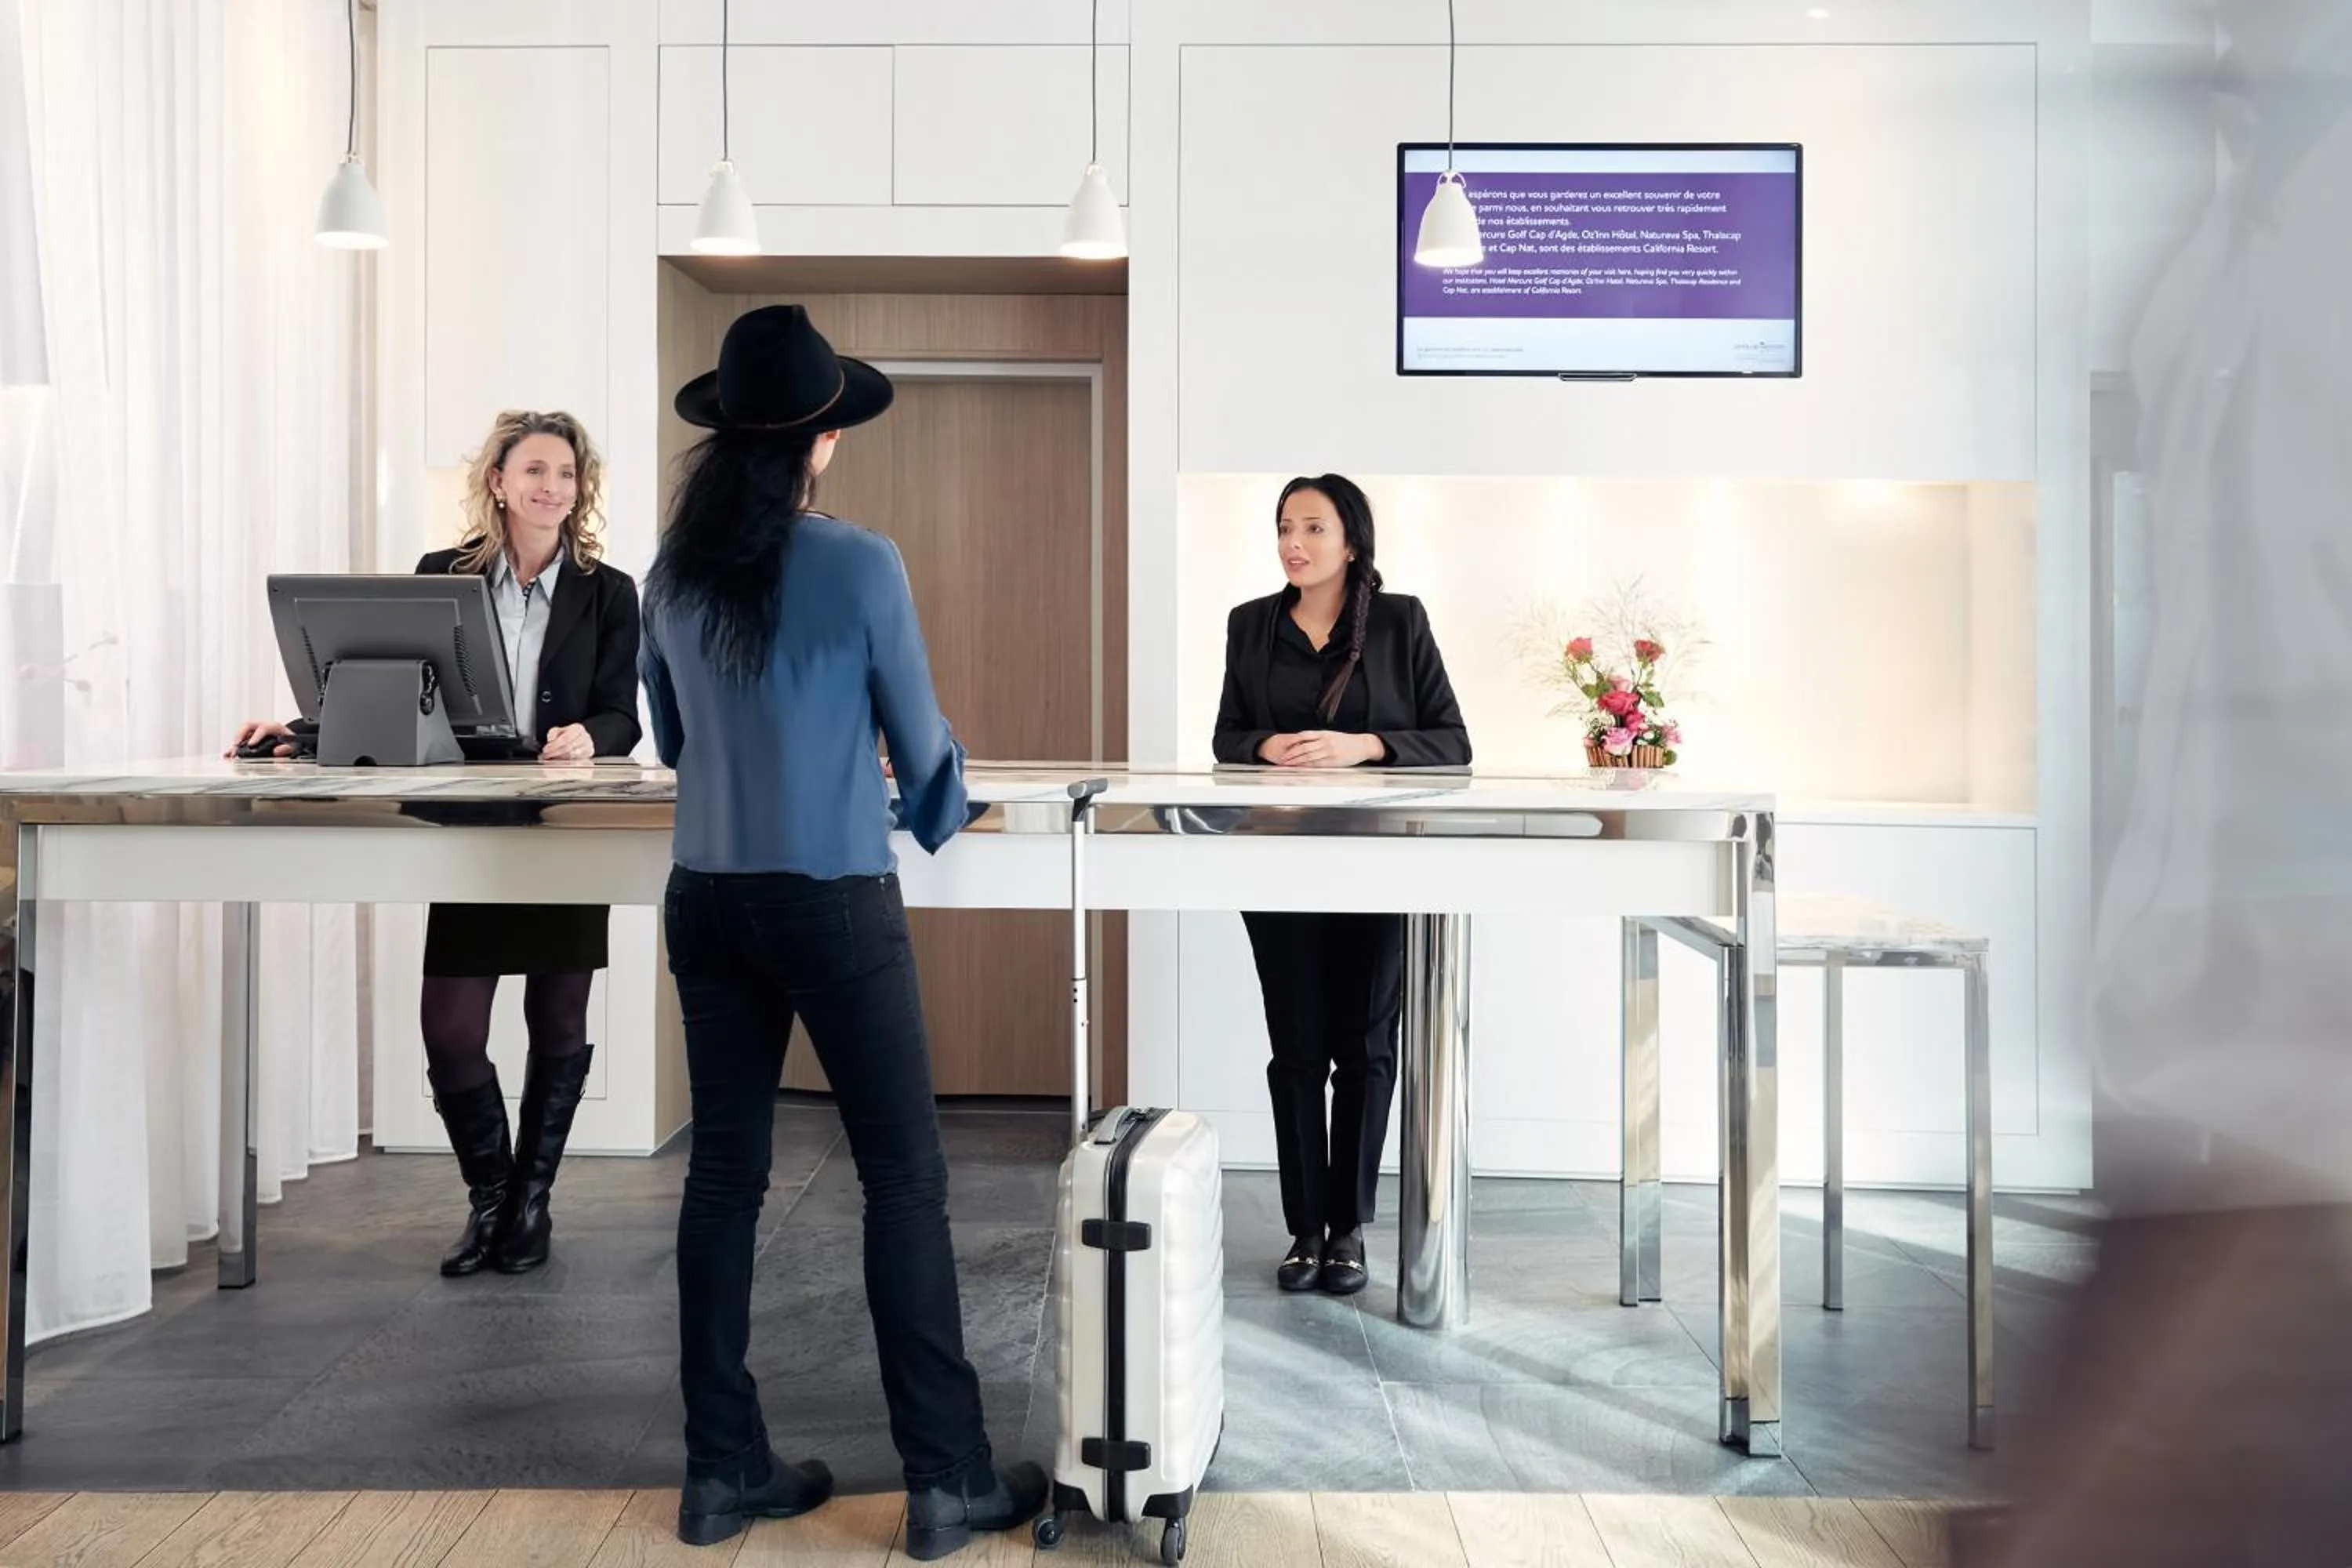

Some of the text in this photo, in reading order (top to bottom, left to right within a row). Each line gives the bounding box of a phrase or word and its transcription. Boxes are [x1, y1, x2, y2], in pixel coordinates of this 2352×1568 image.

[1468, 189, 1507, 201] espérons
[1509, 191, 1526, 200] que
[1550, 190, 1588, 201] garderez
[1603, 189, 1642, 199] excellent
[1644, 191, 1681, 199] souvenir
[1683, 189, 1694, 199] de
[1479, 204, 1504, 213] parmi
[1544, 203, 1589, 212] souhaitant
[1677, 203, 1727, 214] rapidement
[1508, 230, 1526, 239] Golf
[1529, 230, 1547, 240] Cap
[1488, 244, 1498, 252] et
[1499, 243, 1517, 254] Cap
[1559, 244, 1576, 252] des
[1577, 242, 1641, 253] établissements
[1642, 243, 1685, 253] California
